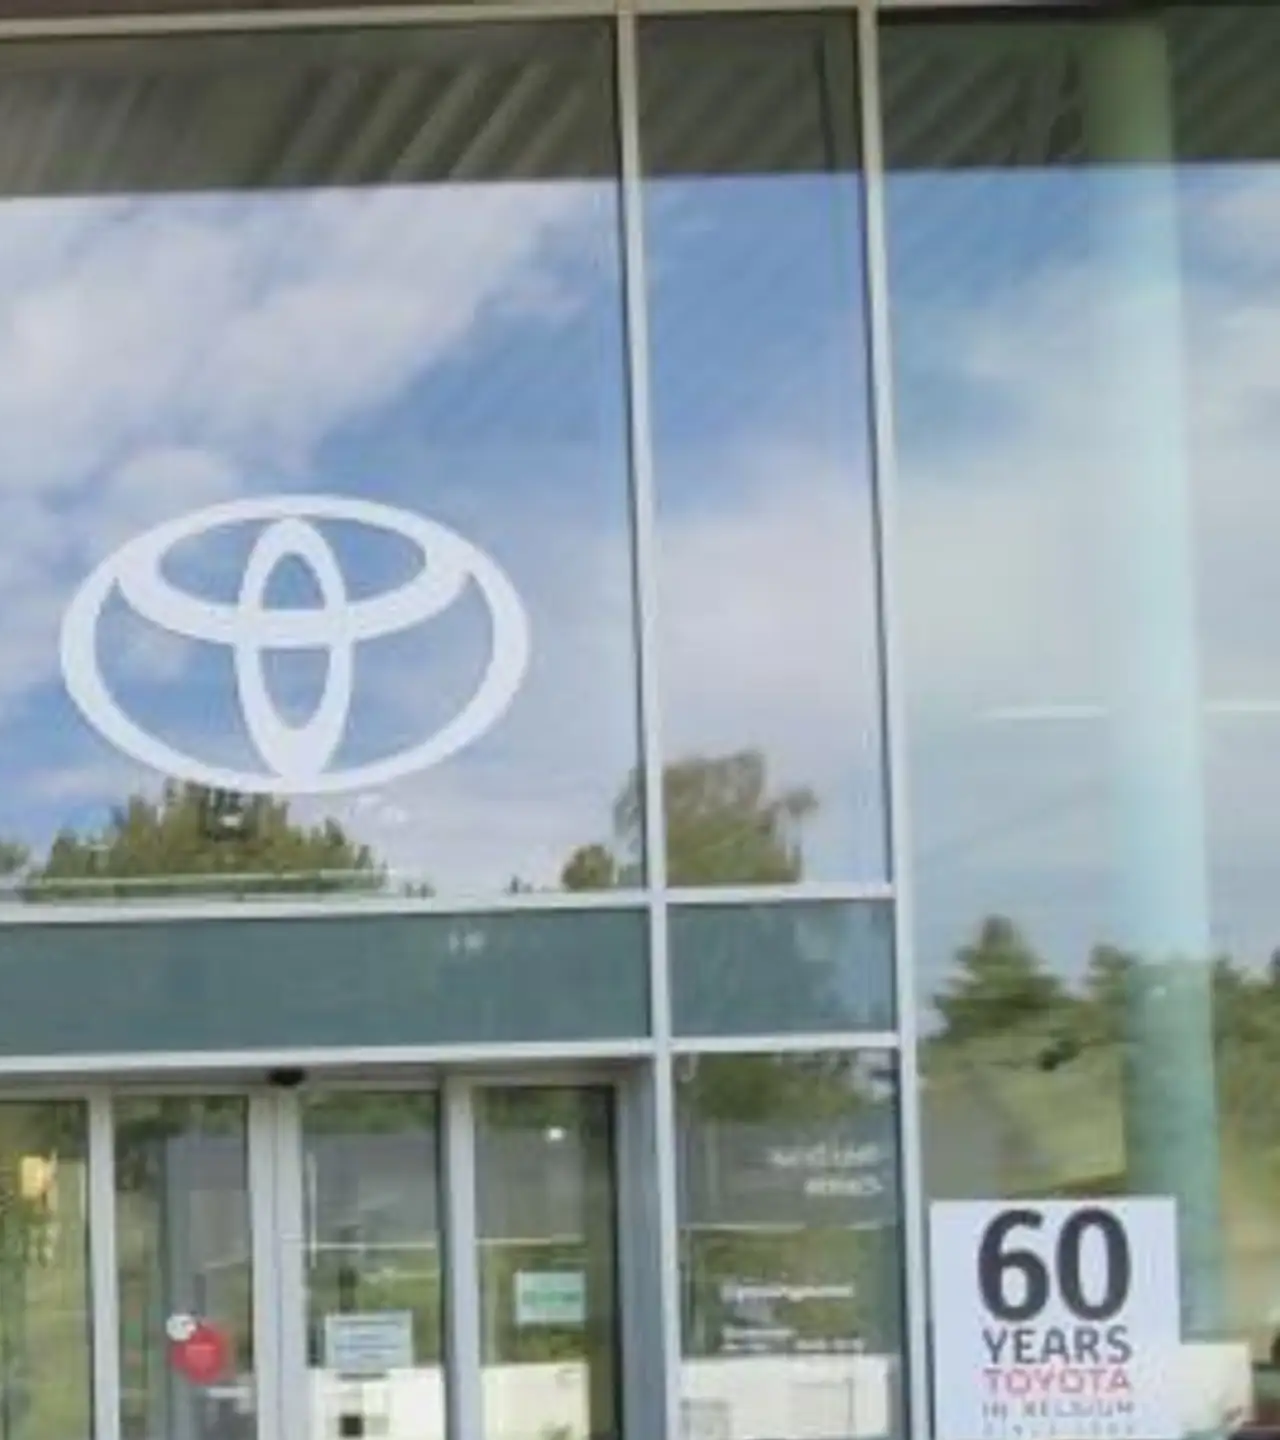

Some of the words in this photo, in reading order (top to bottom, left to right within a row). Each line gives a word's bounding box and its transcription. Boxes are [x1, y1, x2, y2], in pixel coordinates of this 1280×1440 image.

[976, 1207, 1133, 1322] 60
[981, 1325, 1134, 1365] YEARS
[982, 1367, 1132, 1396] TOYOTA
